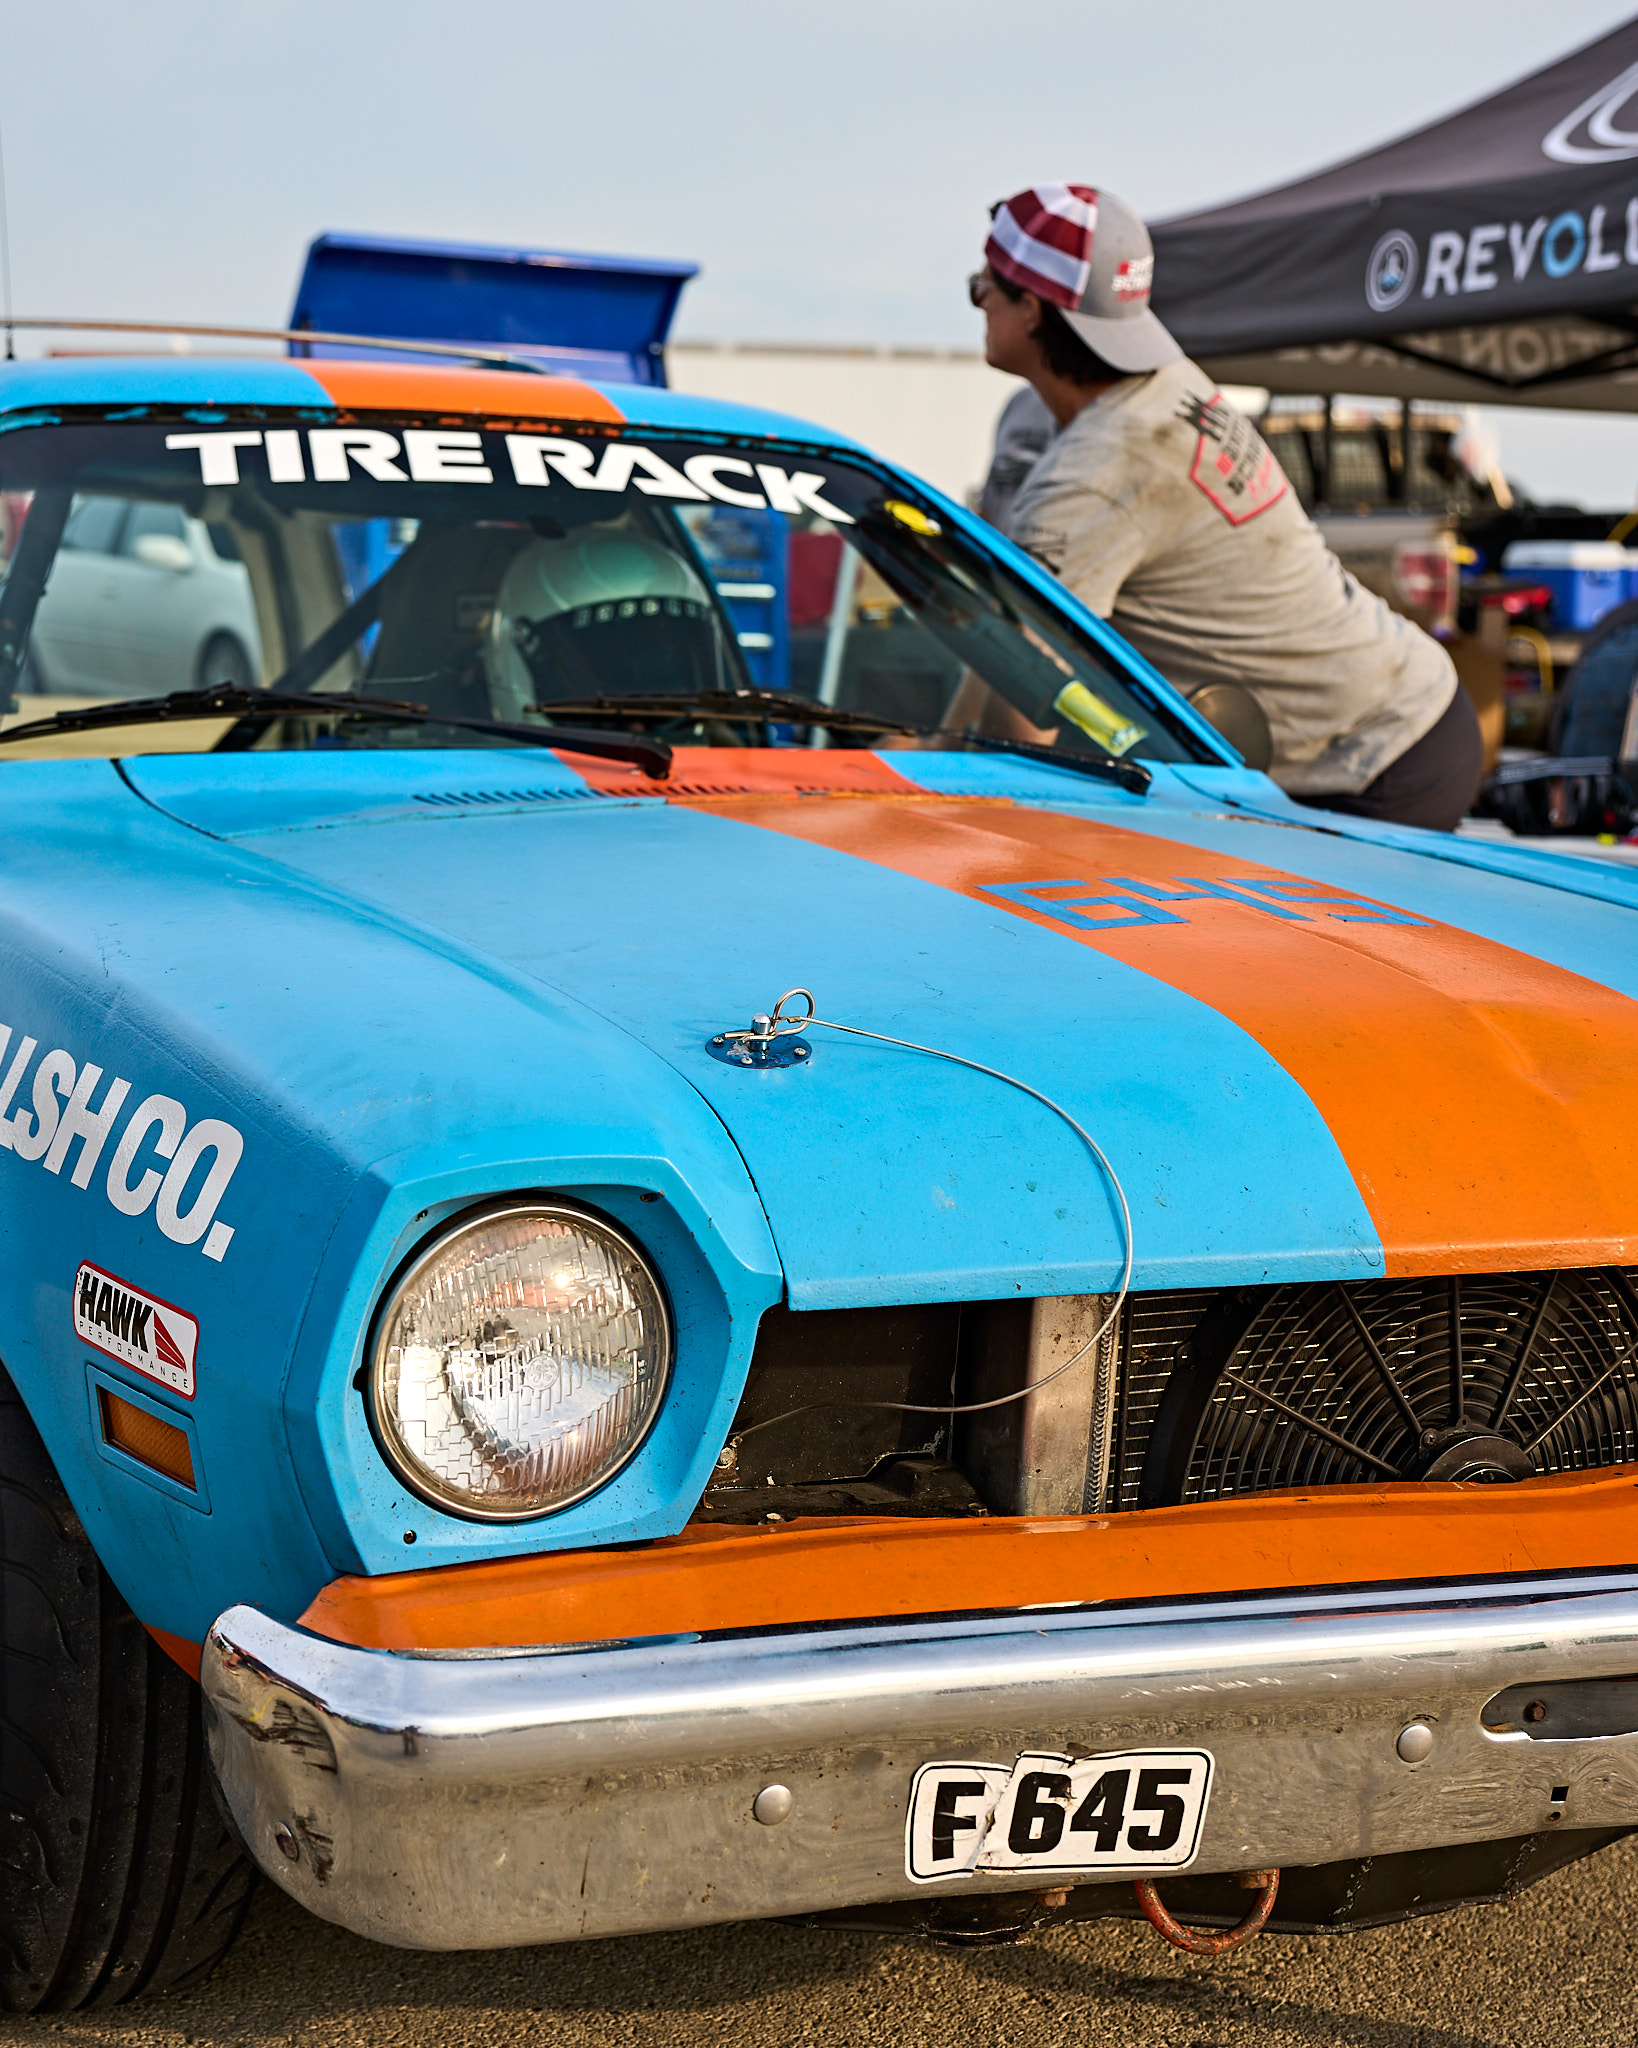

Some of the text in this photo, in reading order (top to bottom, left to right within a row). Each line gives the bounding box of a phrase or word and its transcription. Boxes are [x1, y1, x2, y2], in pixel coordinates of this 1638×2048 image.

[165, 429, 857, 525] TIRE RACK
[974, 876, 1437, 931] 645
[0, 1022, 245, 1263] LSH CO.
[79, 1270, 154, 1354] HAWK
[79, 1320, 189, 1390] PERFORMANCE
[932, 1768, 1192, 1862] F 645
